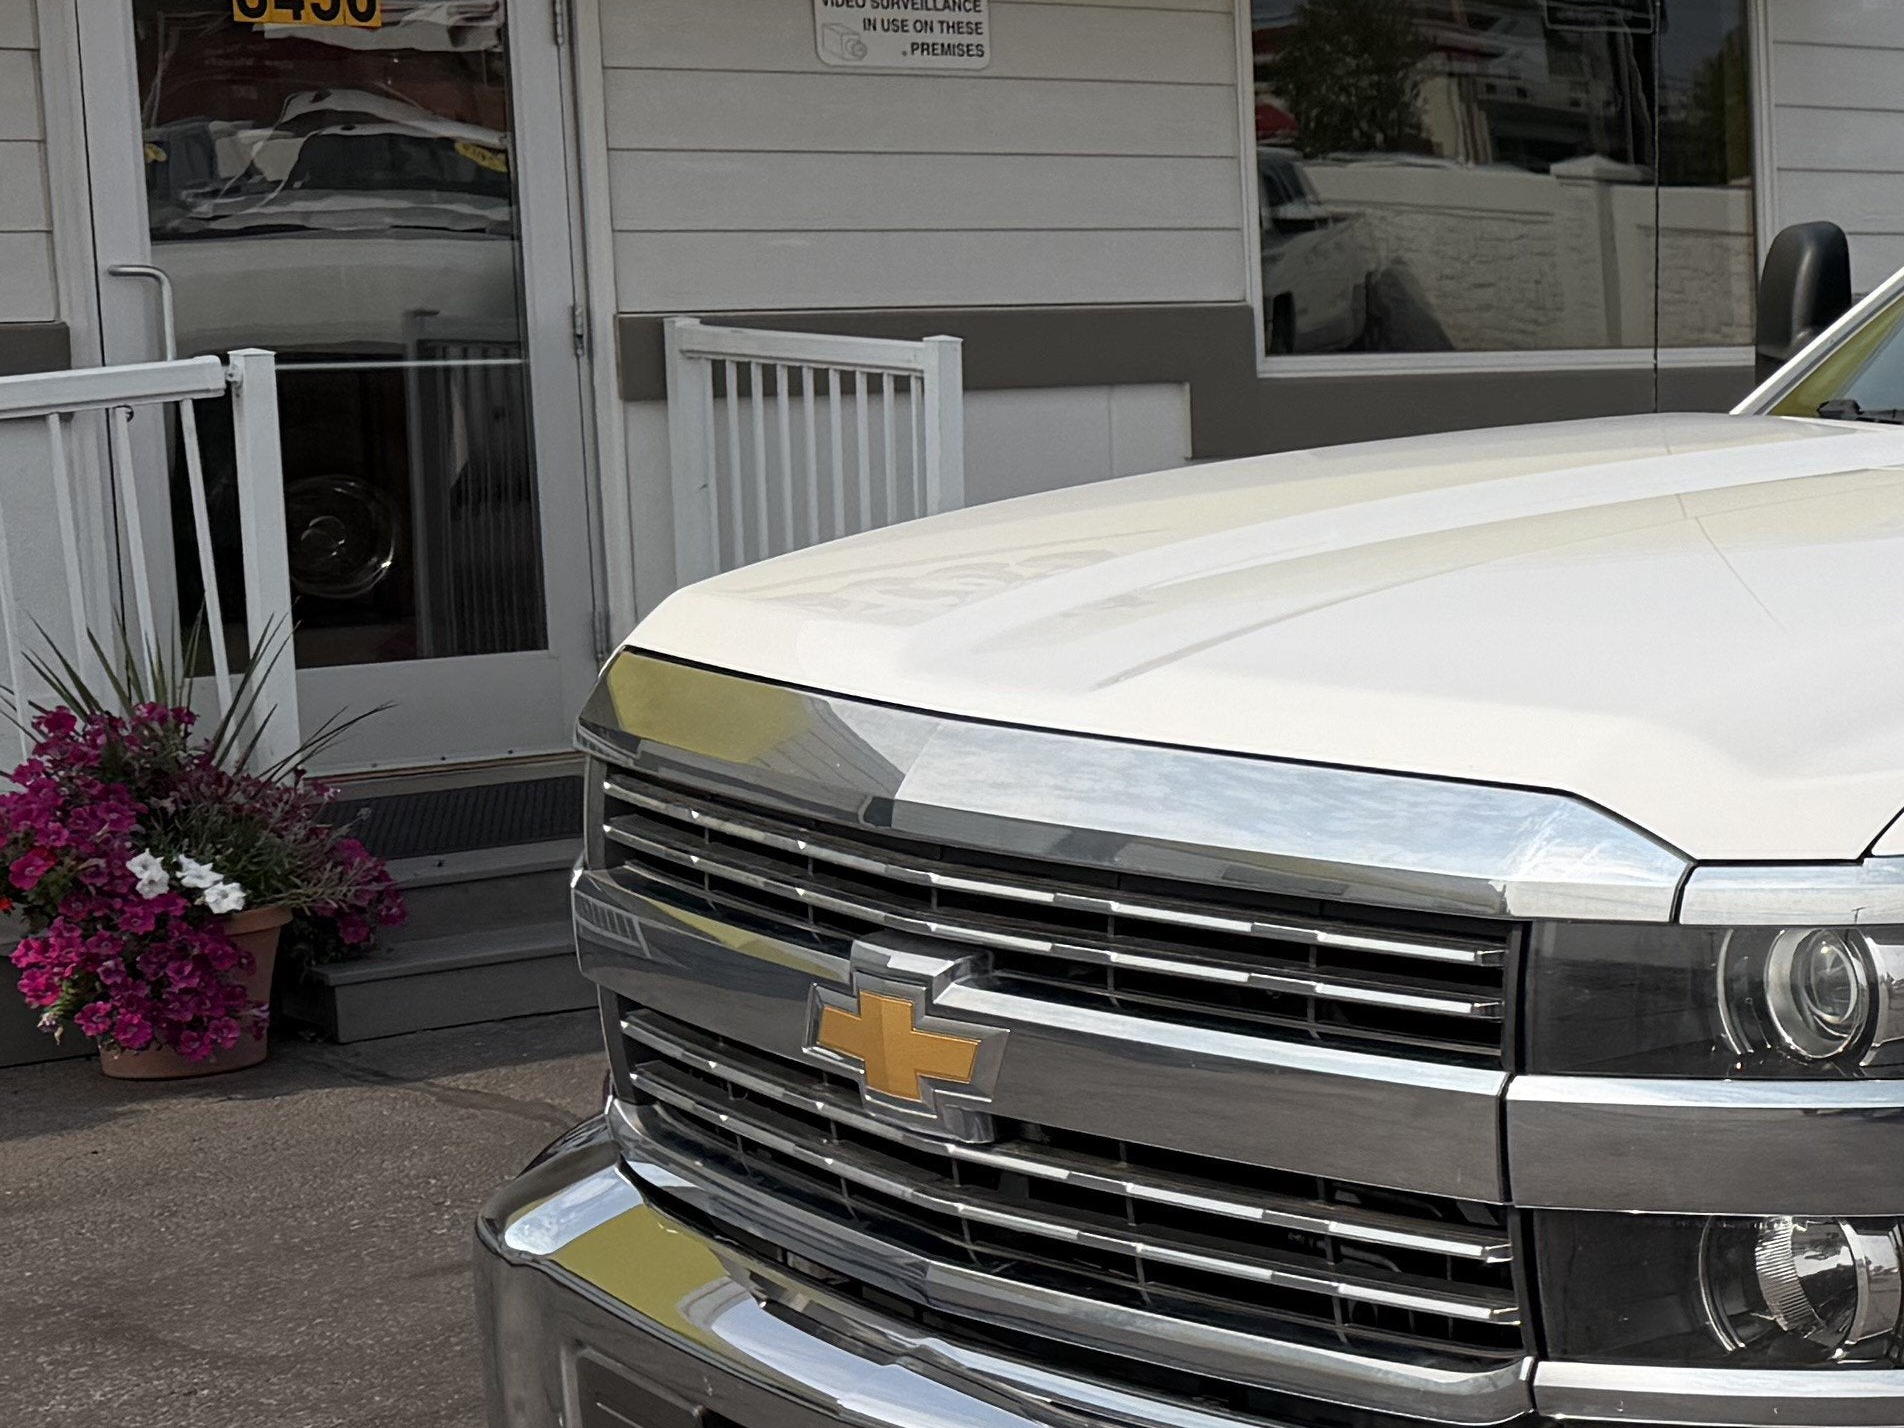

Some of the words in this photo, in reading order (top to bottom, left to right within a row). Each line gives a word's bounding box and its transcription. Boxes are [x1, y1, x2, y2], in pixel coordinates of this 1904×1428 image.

[863, 18, 877, 32] IN
[881, 18, 909, 33] USE
[913, 19, 934, 34] ON
[938, 20, 984, 36] THESE
[910, 41, 985, 58] PREMISES
